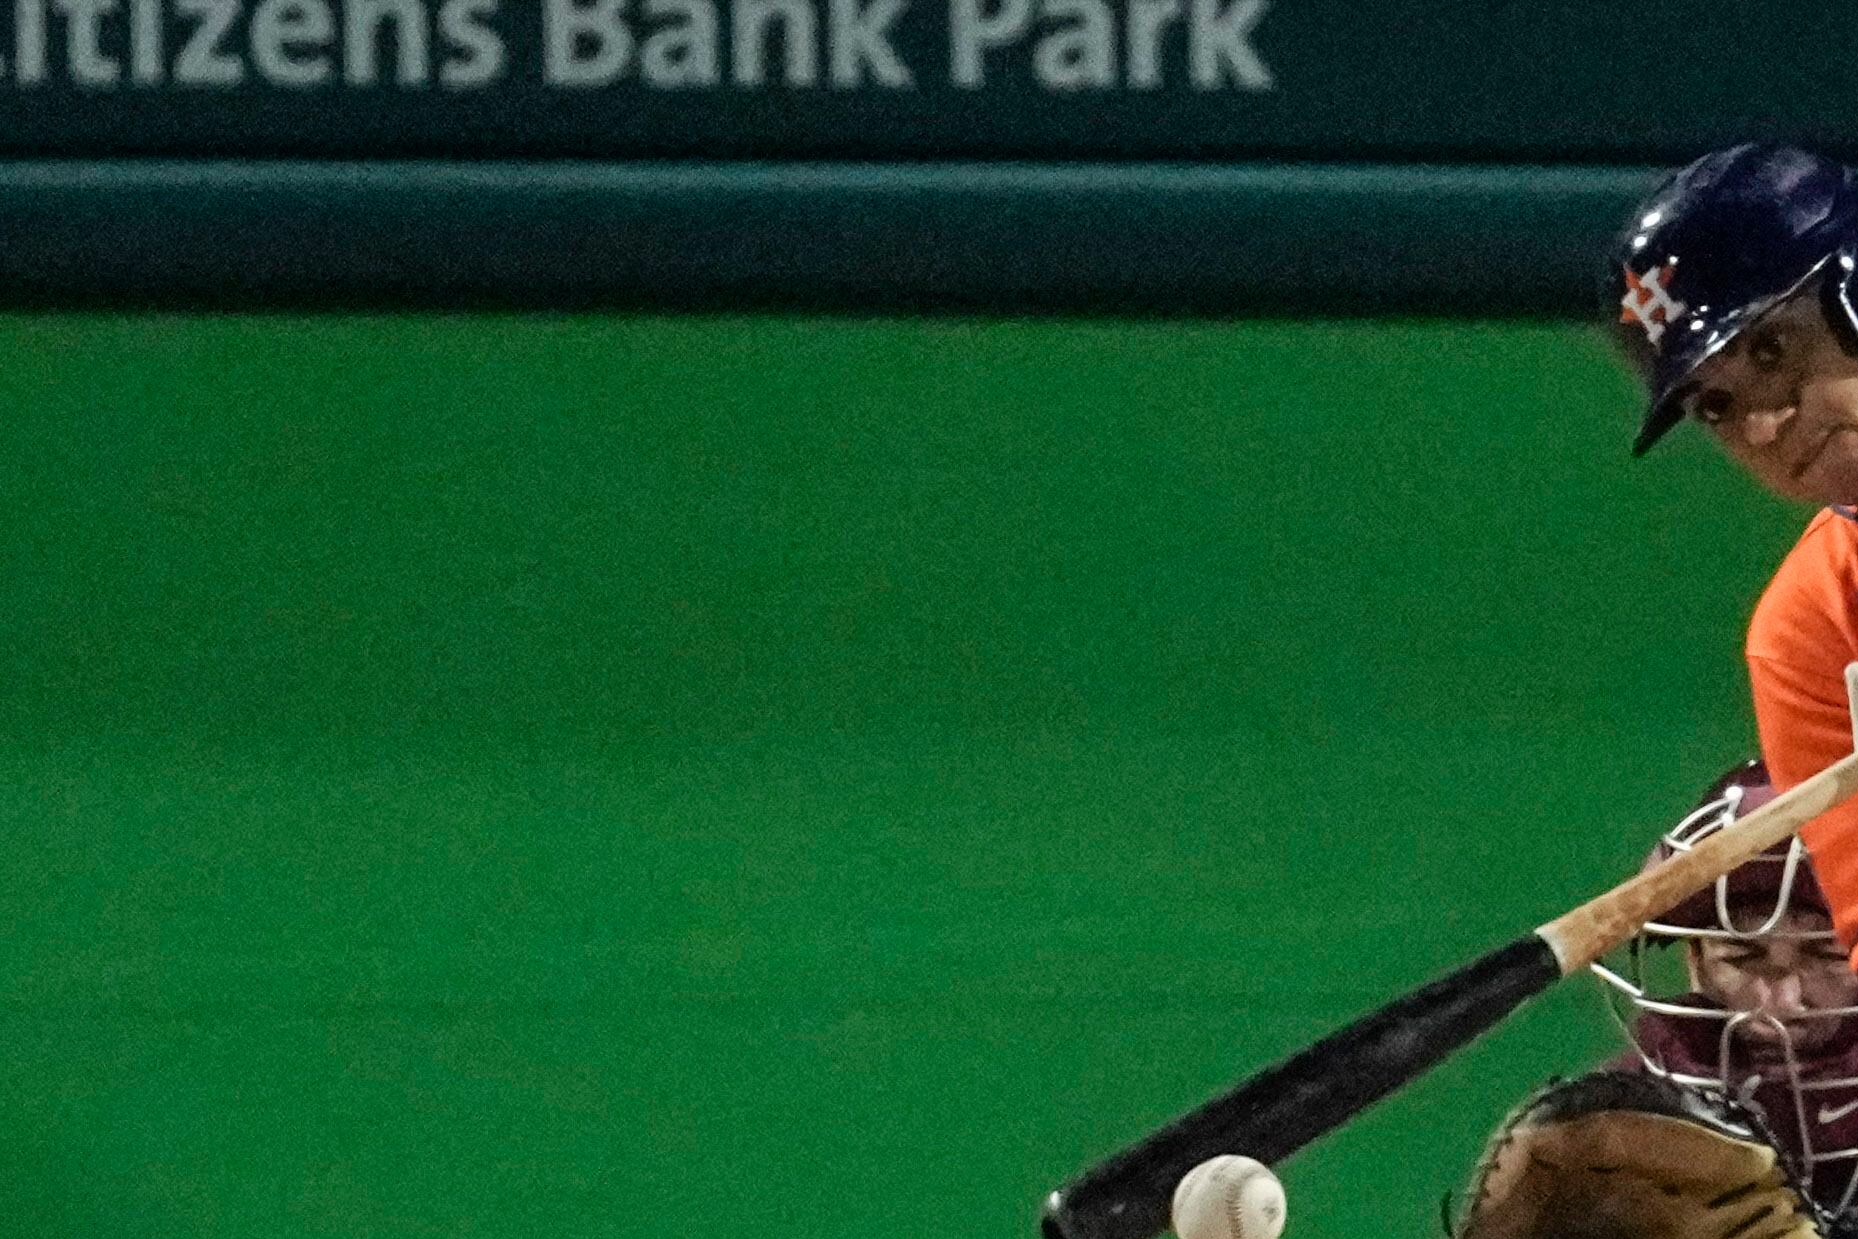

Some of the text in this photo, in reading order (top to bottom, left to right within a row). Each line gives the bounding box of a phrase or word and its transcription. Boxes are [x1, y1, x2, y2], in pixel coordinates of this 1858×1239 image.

[0, 0, 1273, 88] itizens Bank Park
